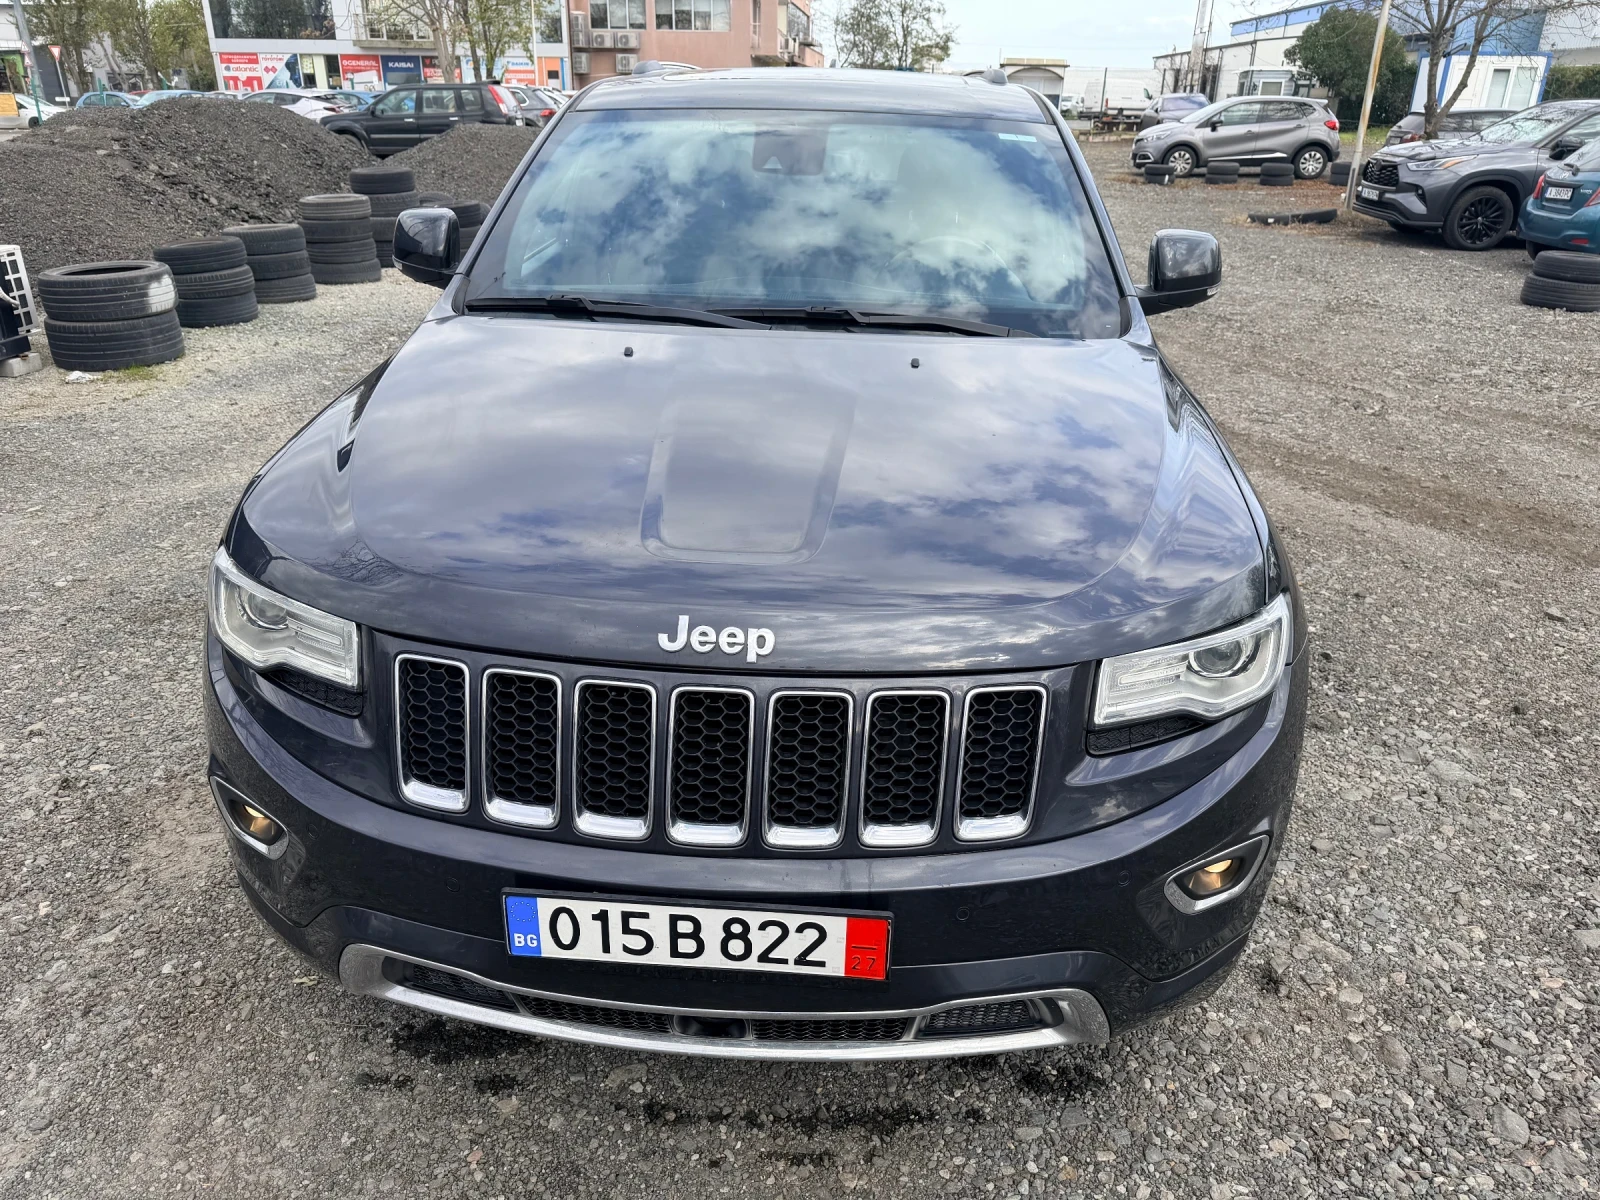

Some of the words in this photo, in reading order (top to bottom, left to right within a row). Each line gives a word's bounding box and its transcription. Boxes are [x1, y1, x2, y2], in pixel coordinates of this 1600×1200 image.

[232, 65, 259, 73] atlantic
[658, 615, 775, 663] Jeep
[514, 933, 538, 948] BG
[669, 913, 705, 959] B
[720, 917, 828, 967] 822
[851, 955, 877, 971] 27
